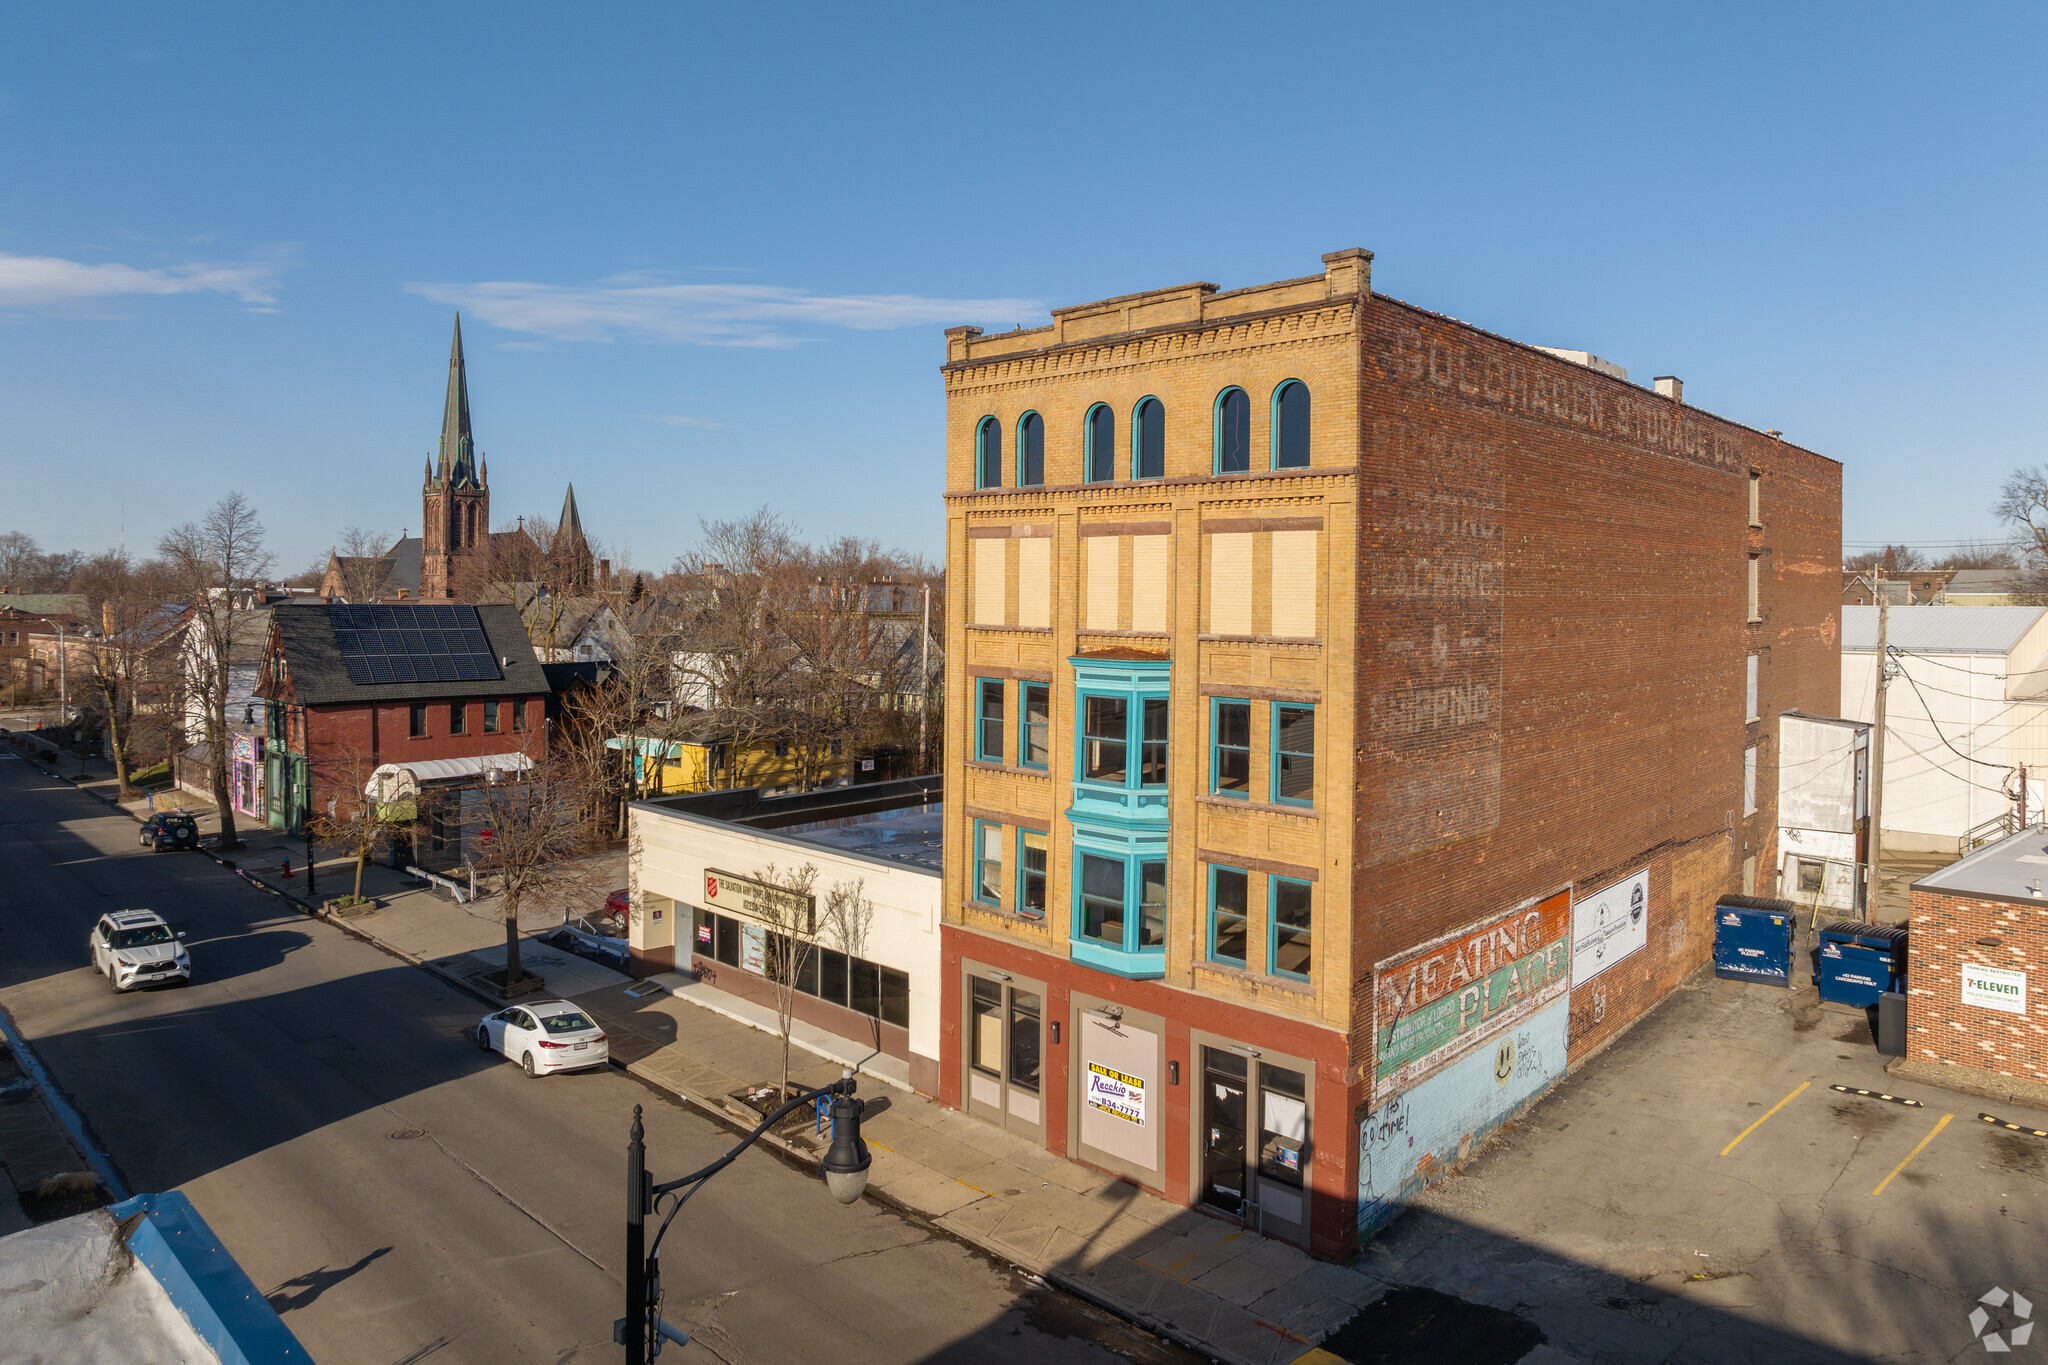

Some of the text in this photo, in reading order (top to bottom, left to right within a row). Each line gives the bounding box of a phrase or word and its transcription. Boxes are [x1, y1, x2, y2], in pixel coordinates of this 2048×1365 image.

[1380, 910, 1542, 1023] MEATING
[1966, 965, 1989, 973] PARKING
[1989, 969, 2022, 978] RESTRICTED
[1457, 941, 1566, 1034] PLACE
[1090, 1063, 1143, 1089] SALE OR LEASE
[1091, 1075, 1127, 1095] Recckio
[1101, 1097, 1140, 1118] 834-7777
